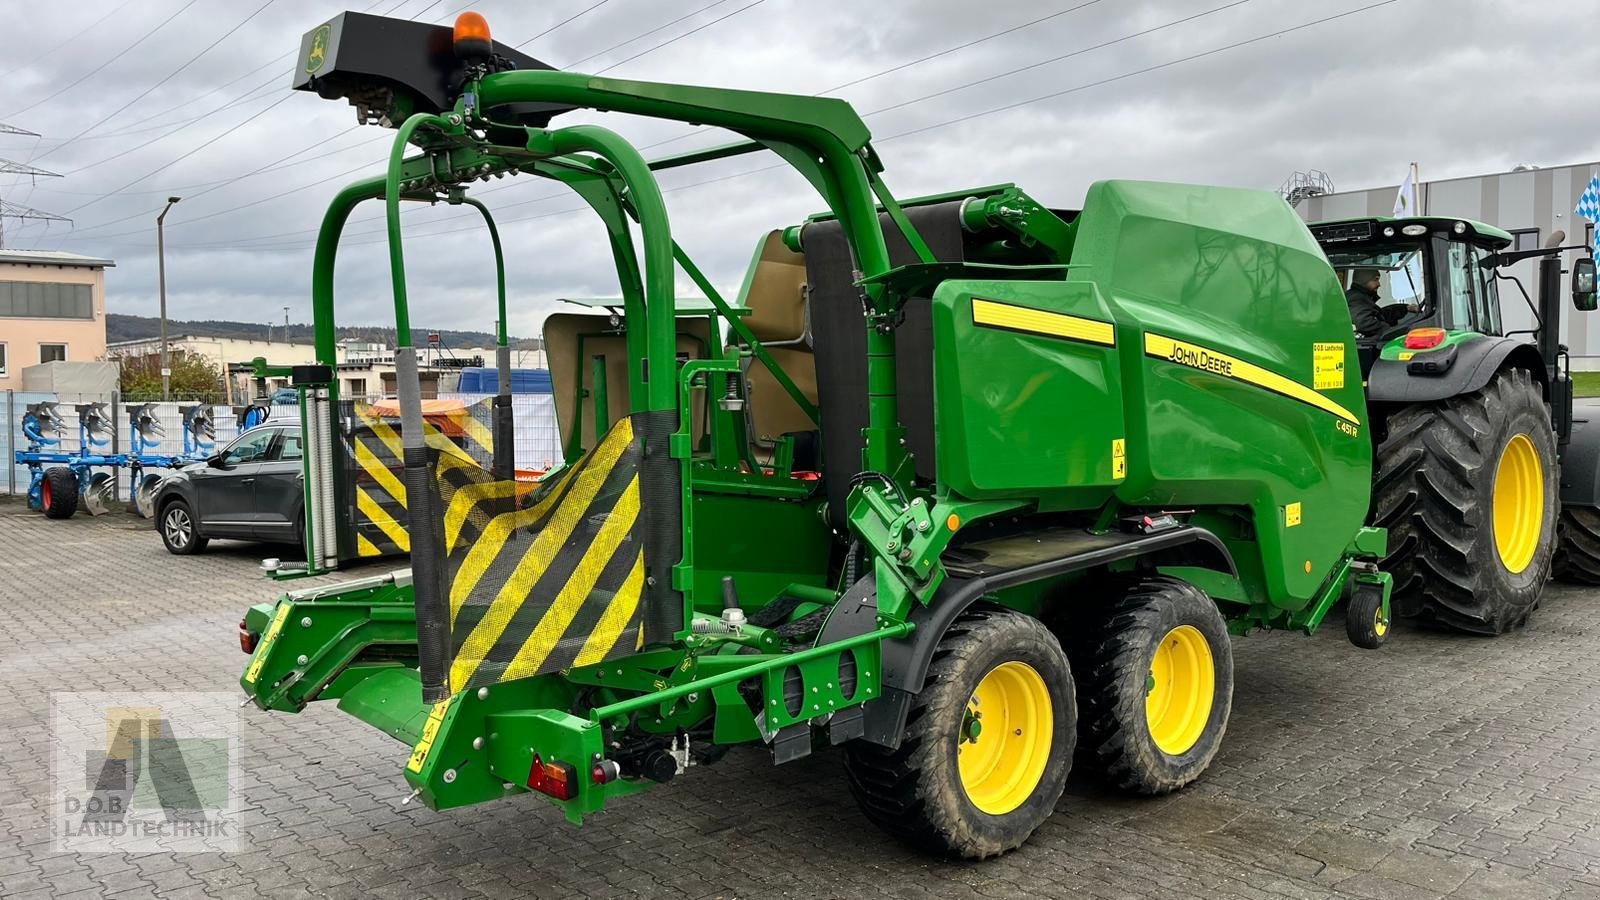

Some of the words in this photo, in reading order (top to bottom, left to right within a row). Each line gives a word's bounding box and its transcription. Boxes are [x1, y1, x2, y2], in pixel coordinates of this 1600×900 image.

[1169, 343, 1198, 365] JOHN
[1200, 351, 1232, 375] DEERE
[1335, 419, 1341, 430] C
[1341, 422, 1352, 435] 451
[1352, 426, 1358, 438] R
